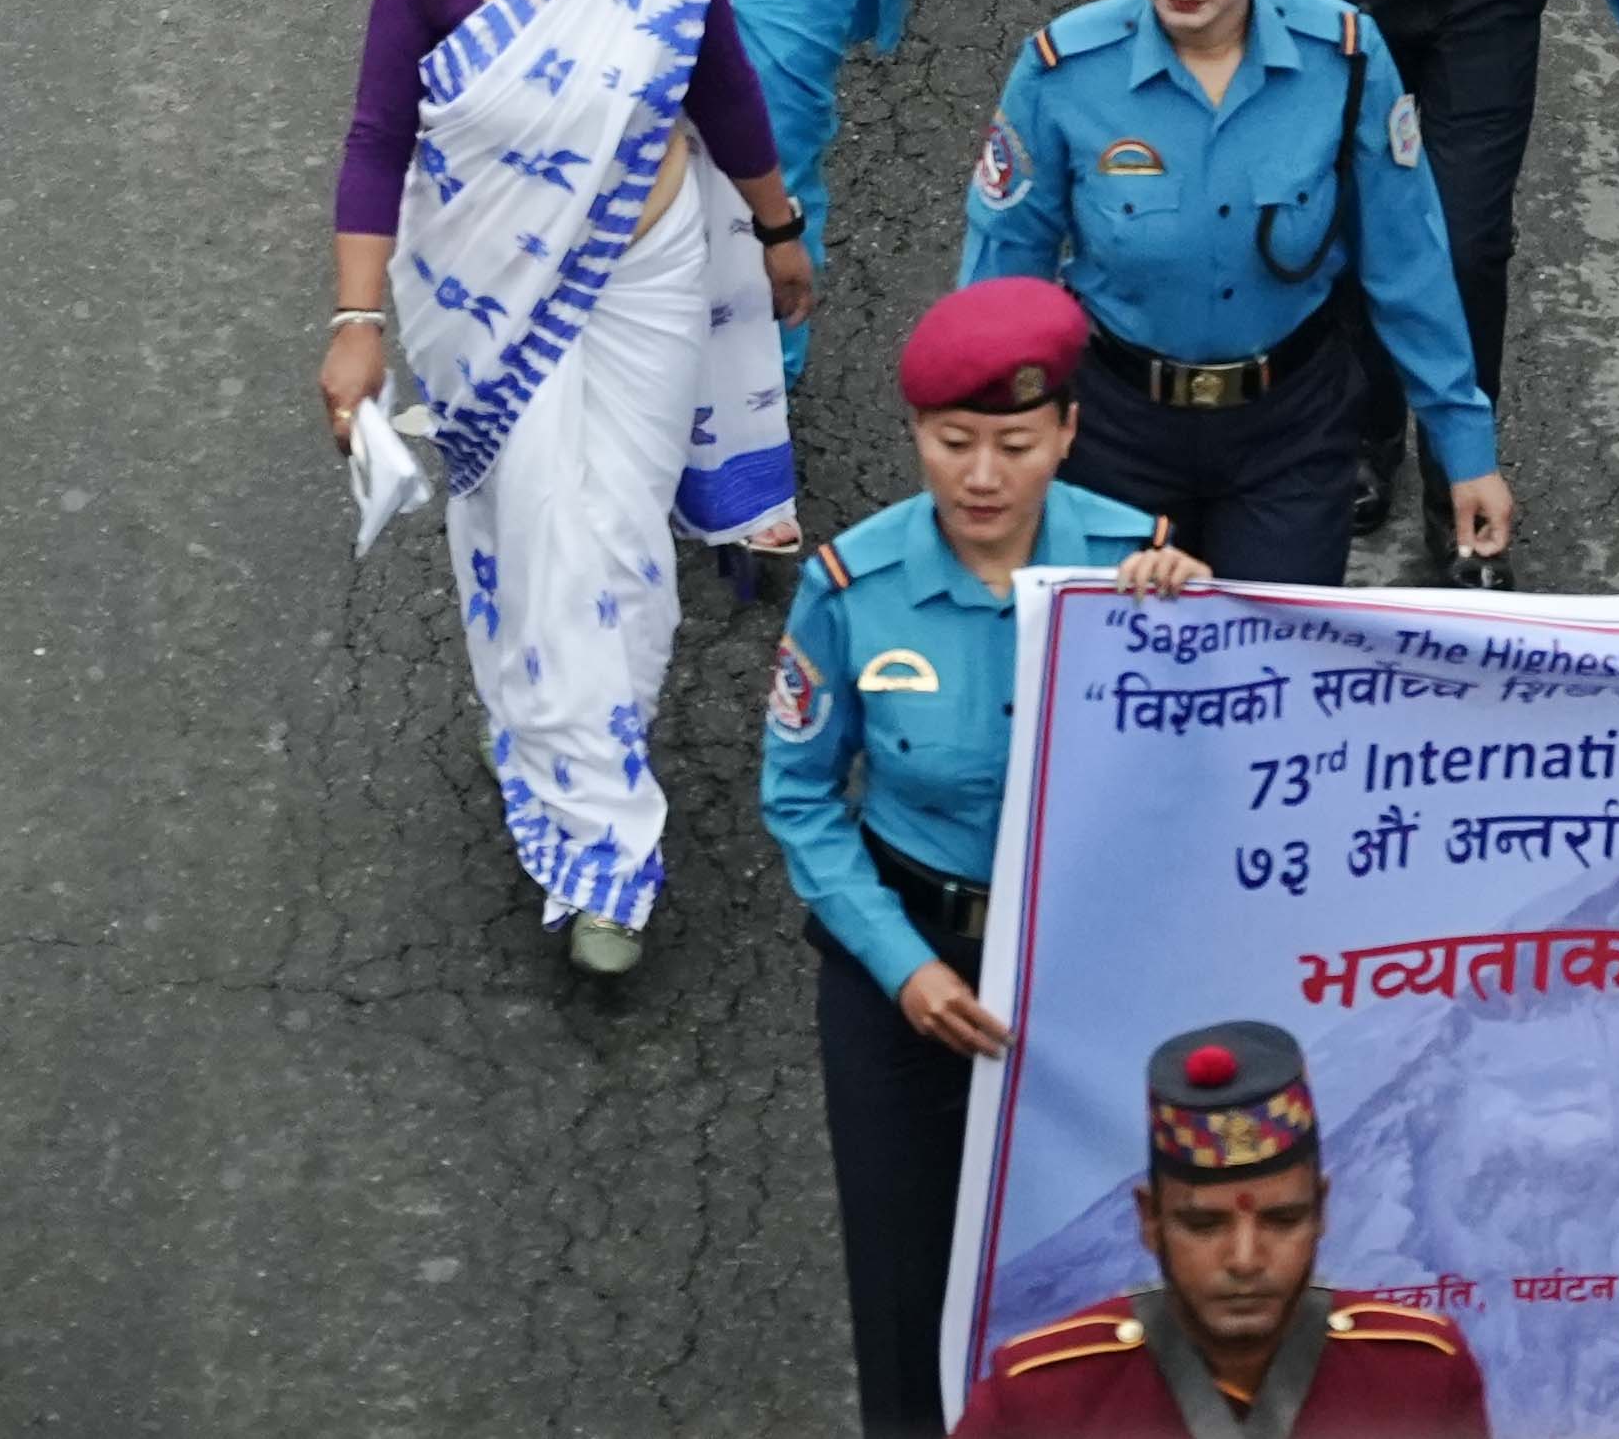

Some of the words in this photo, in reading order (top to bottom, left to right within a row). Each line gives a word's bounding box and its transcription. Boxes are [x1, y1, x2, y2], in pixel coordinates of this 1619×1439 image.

[1396, 630, 1468, 666] The
[1248, 741, 1348, 811] 73rd
[1236, 840, 1310, 896] ७३
[1347, 805, 1420, 877] औं
[1512, 1267, 1619, 1303] पर्यटन
